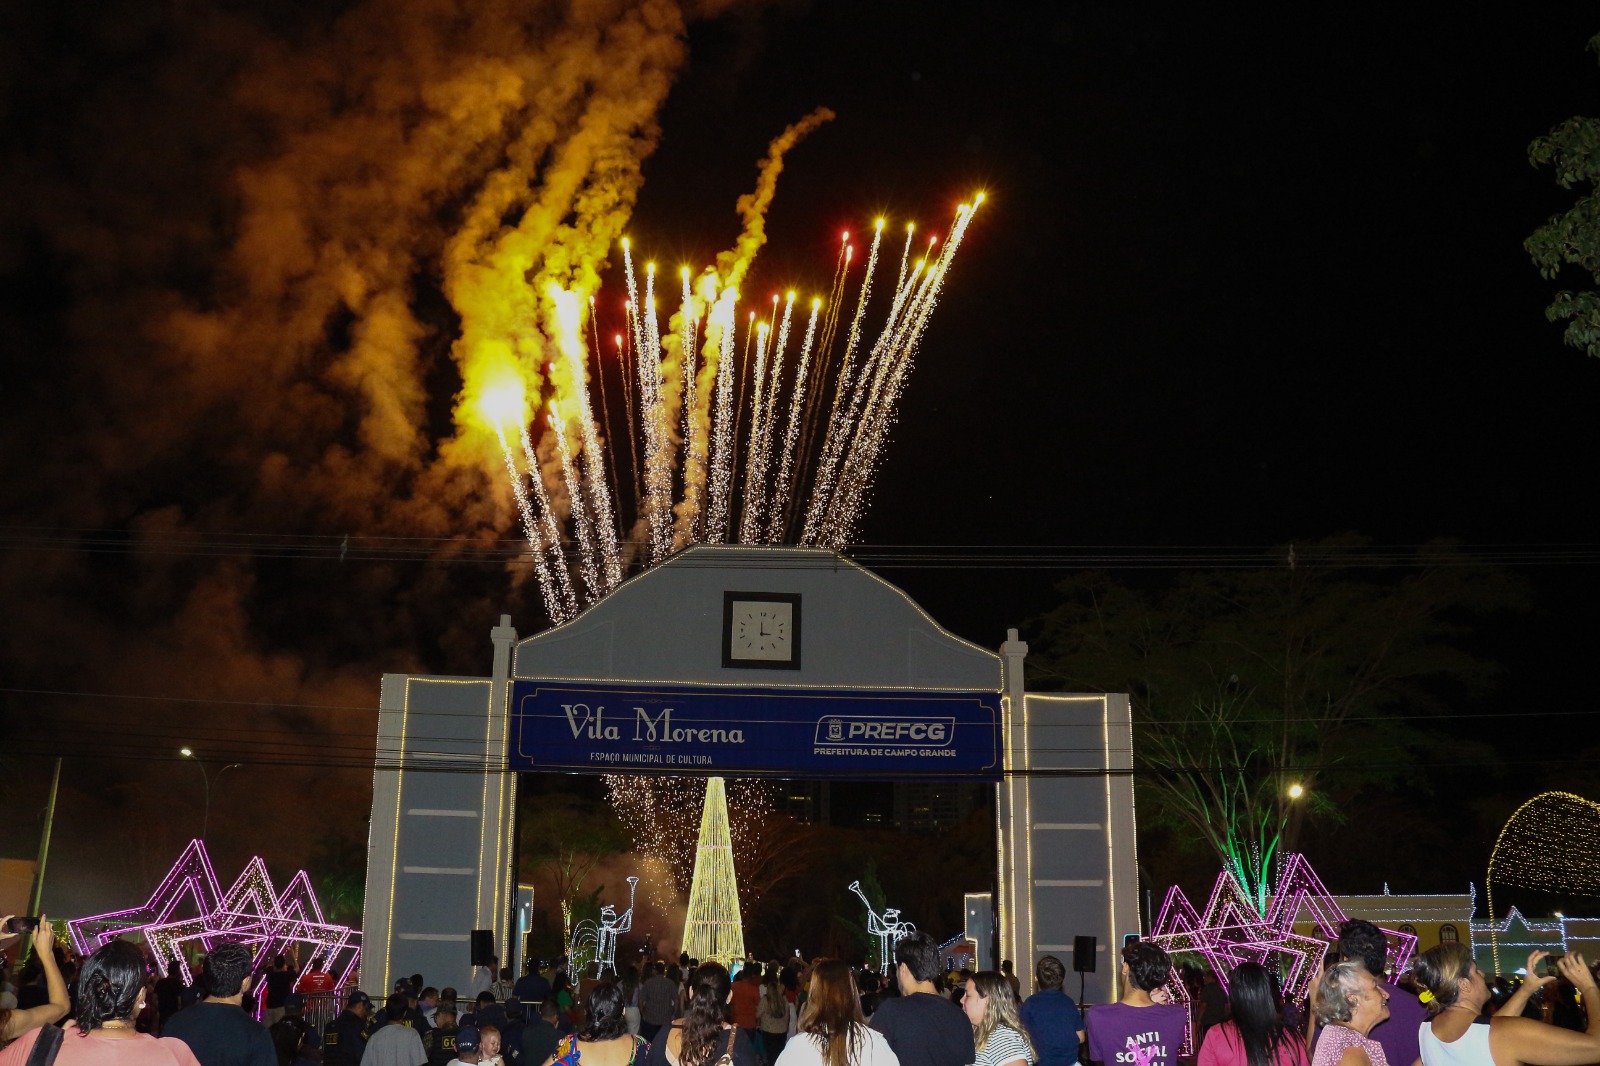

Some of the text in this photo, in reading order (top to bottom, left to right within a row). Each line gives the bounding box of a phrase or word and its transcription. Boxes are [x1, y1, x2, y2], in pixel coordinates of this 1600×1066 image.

[561, 703, 745, 743] Vila Morena
[848, 722, 946, 740] PREFCG
[590, 752, 713, 765] ESPAÇO MUNICIPAL DE CULTURA
[814, 748, 956, 757] PREFEITURA DE CAMPO GRANDE
[443, 1038, 456, 1047] GC
[1125, 1031, 1160, 1049] ANTI
